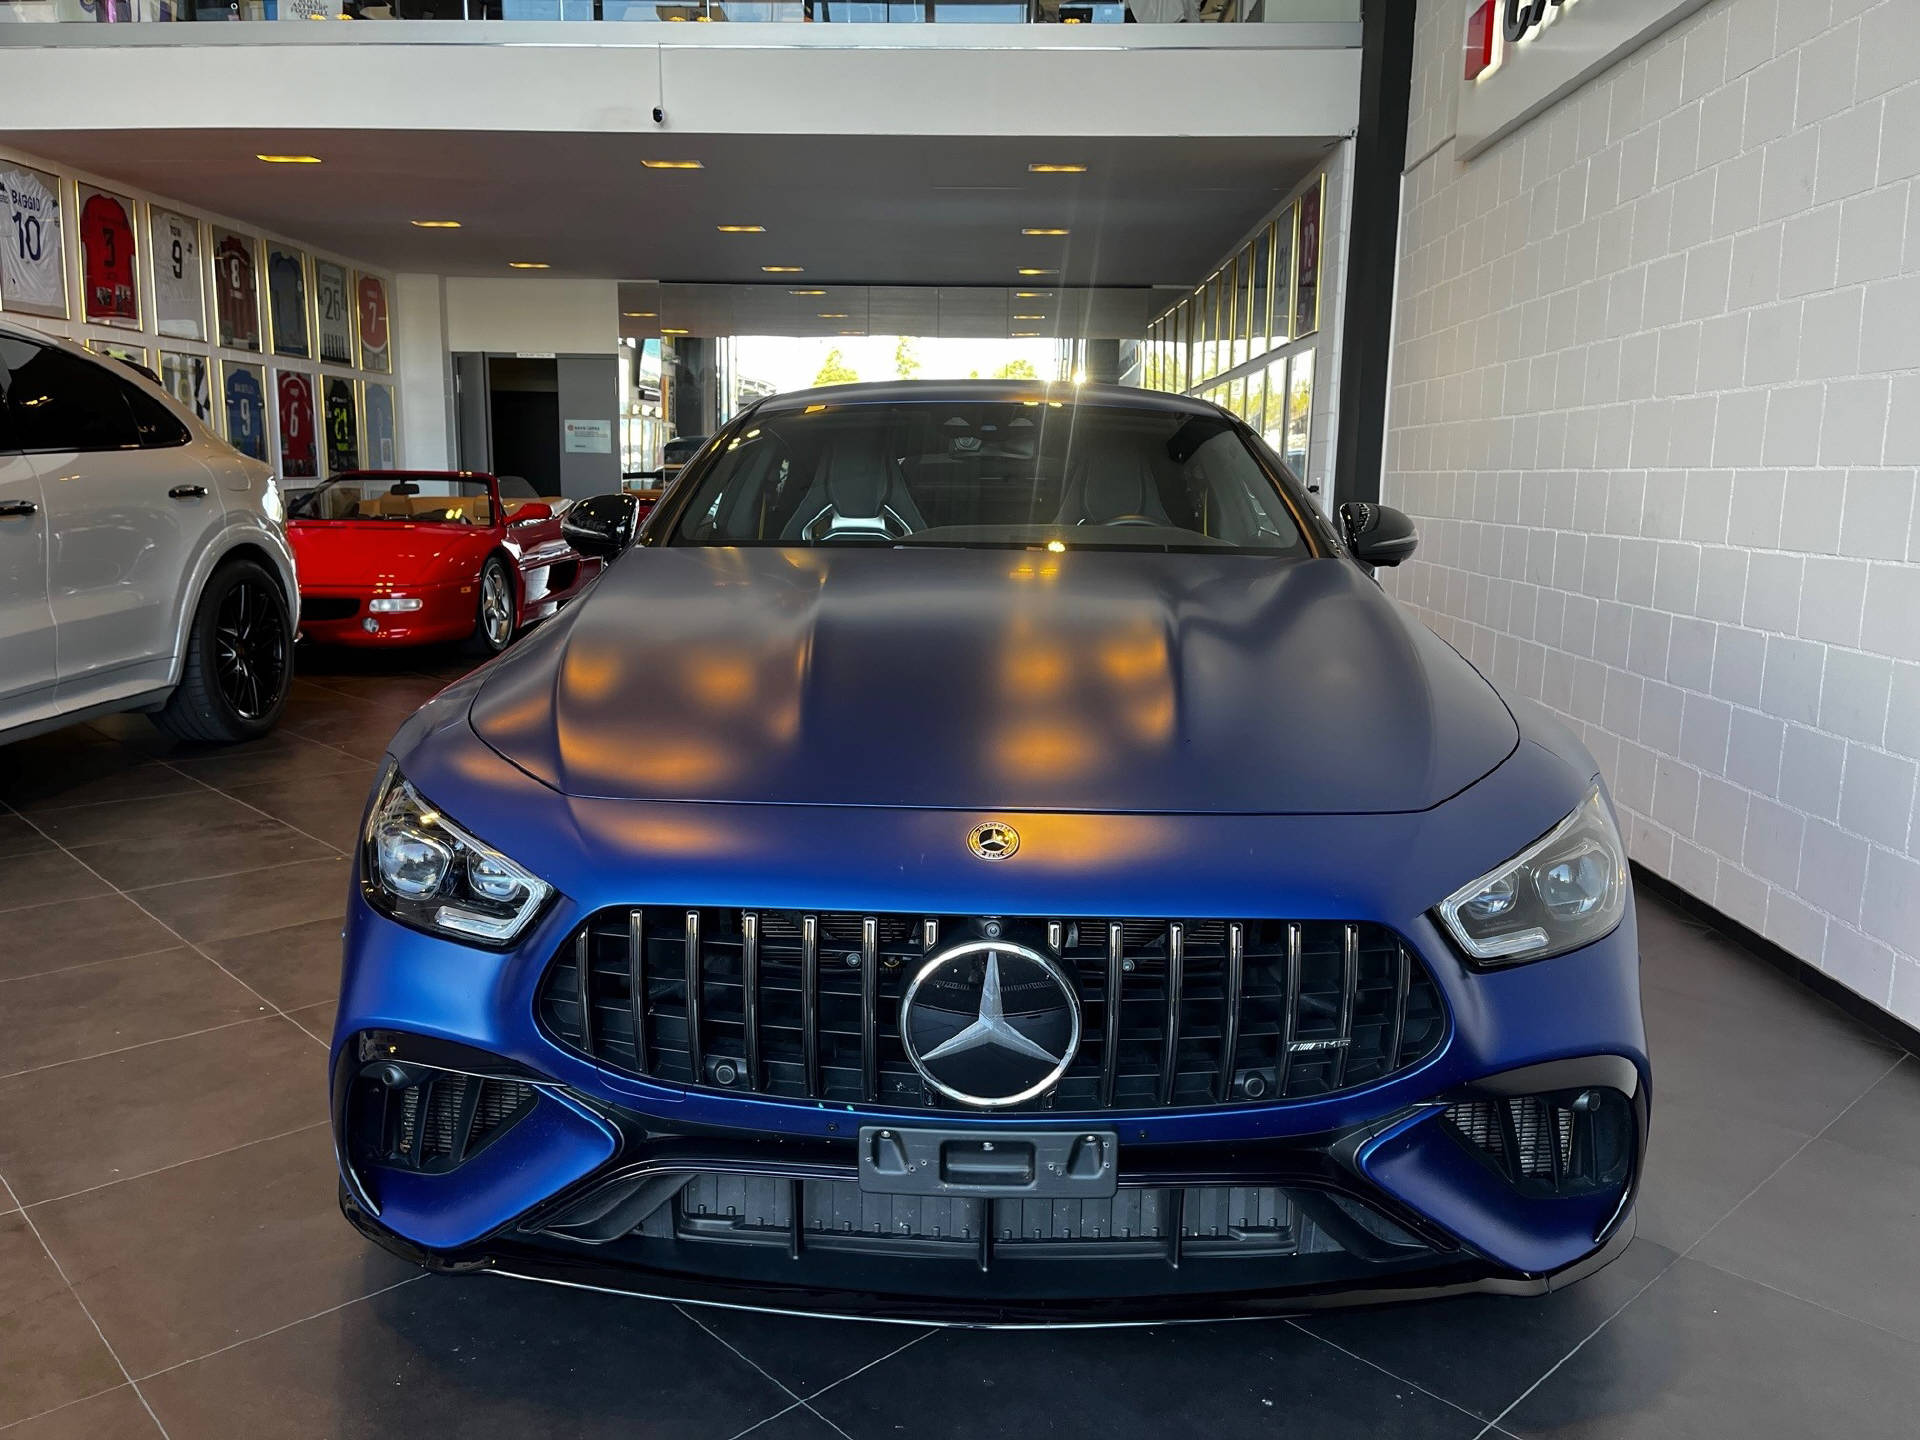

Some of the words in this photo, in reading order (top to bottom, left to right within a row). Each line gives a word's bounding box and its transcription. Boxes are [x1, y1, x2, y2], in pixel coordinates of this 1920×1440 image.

[11, 190, 40, 212] BAGGIO
[12, 211, 41, 261] 10
[102, 227, 115, 267] 3
[172, 240, 182, 279] 9
[230, 259, 240, 288] 8
[324, 287, 341, 320] 26
[368, 302, 377, 333] 7
[241, 399, 251, 436] 9
[290, 402, 298, 437] 6
